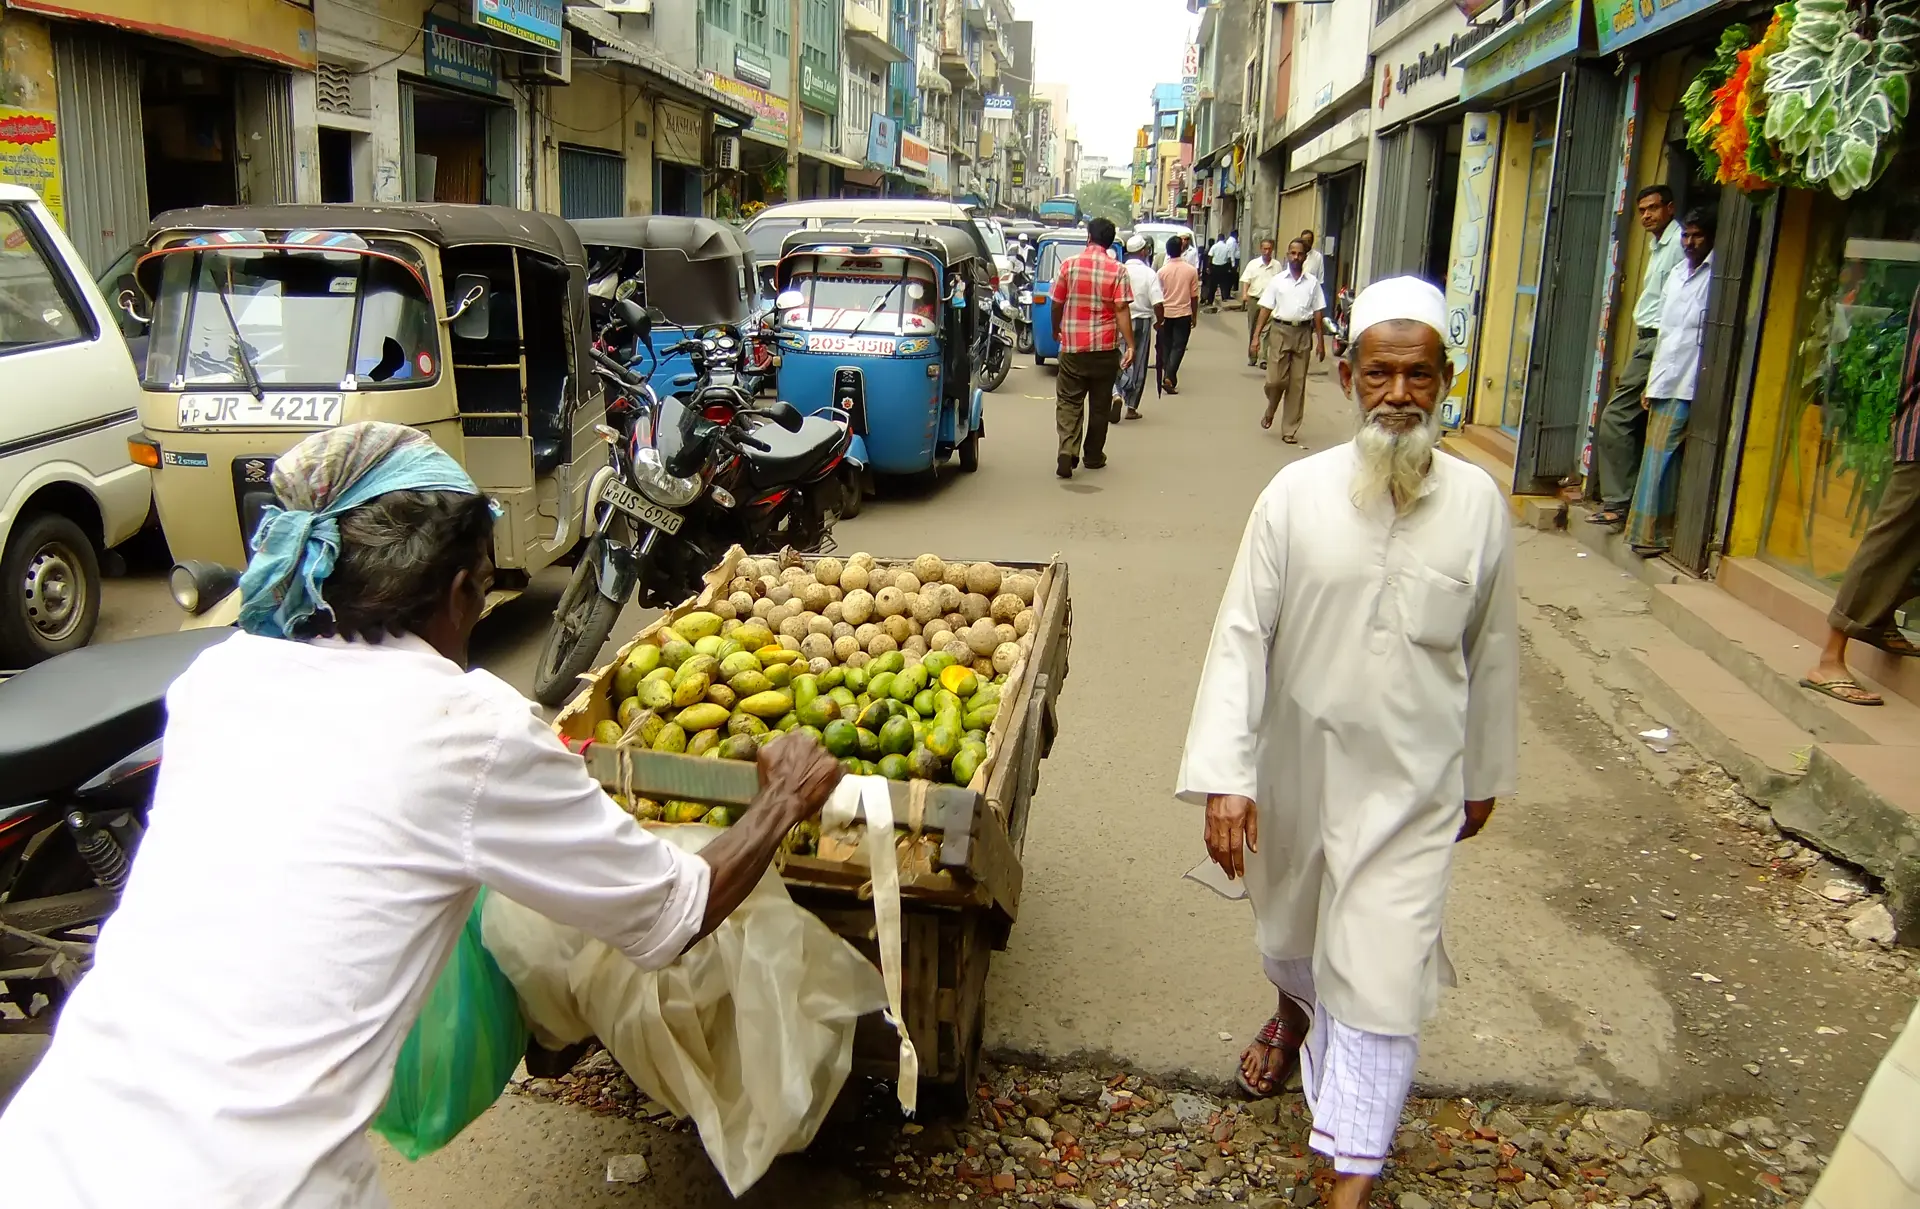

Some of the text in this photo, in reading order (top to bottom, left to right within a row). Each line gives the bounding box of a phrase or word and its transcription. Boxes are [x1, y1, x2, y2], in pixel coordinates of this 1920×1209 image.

[431, 24, 493, 76] SHALIMAR
[810, 336, 895, 355] 205-3518
[164, 452, 177, 464] RE
